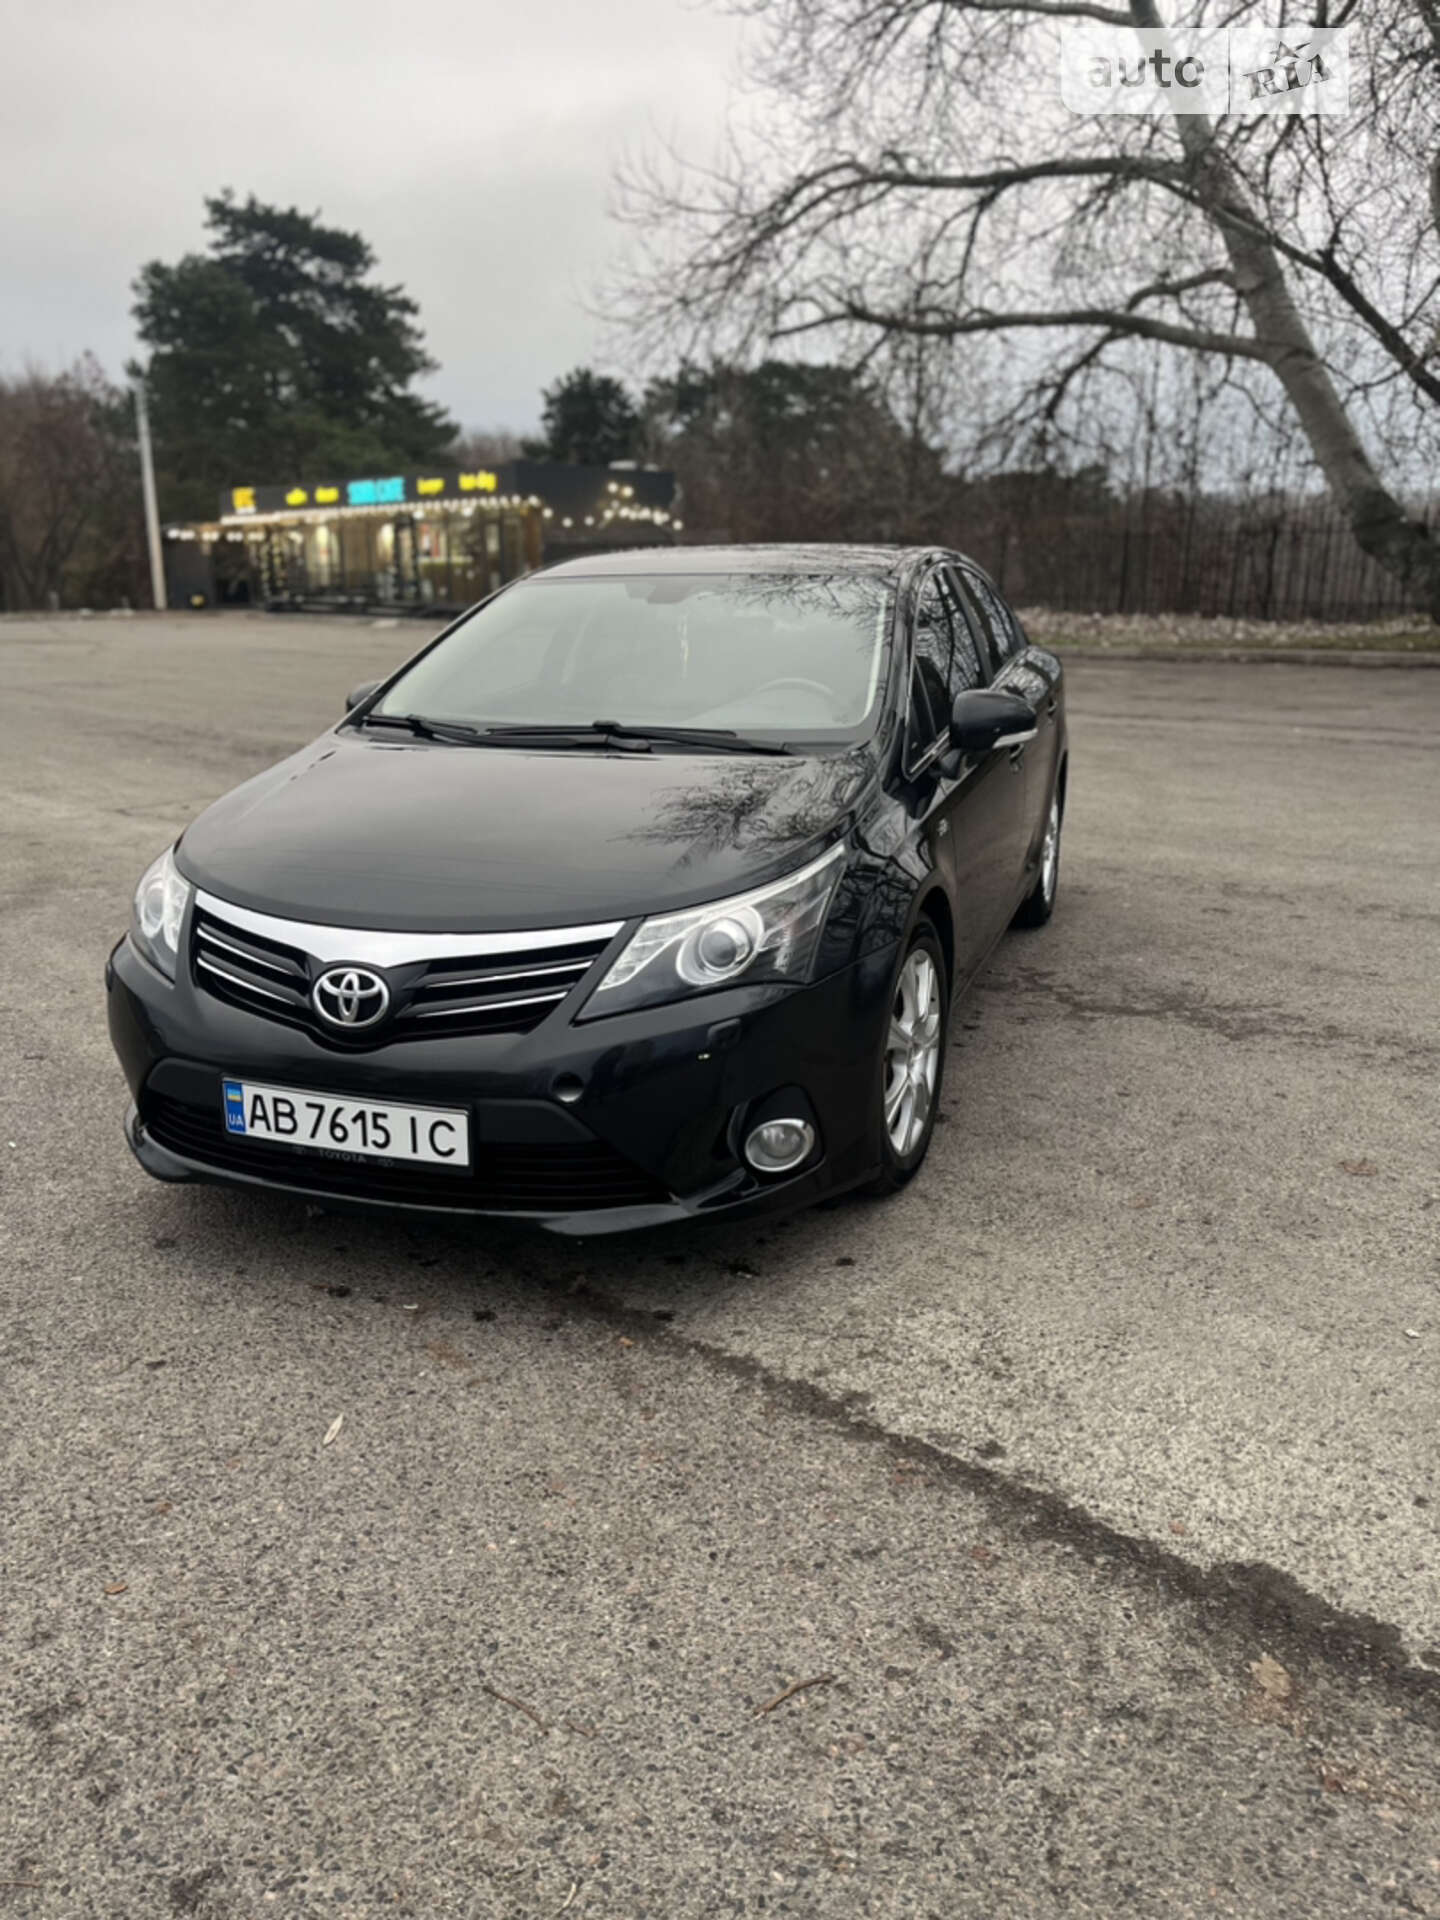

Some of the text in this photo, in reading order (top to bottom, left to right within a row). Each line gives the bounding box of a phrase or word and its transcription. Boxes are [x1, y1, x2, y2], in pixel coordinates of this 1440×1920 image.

[229, 1114, 244, 1127] UA
[249, 1094, 456, 1157] AB 7615 IC
[319, 1148, 367, 1163] TOYOTA
